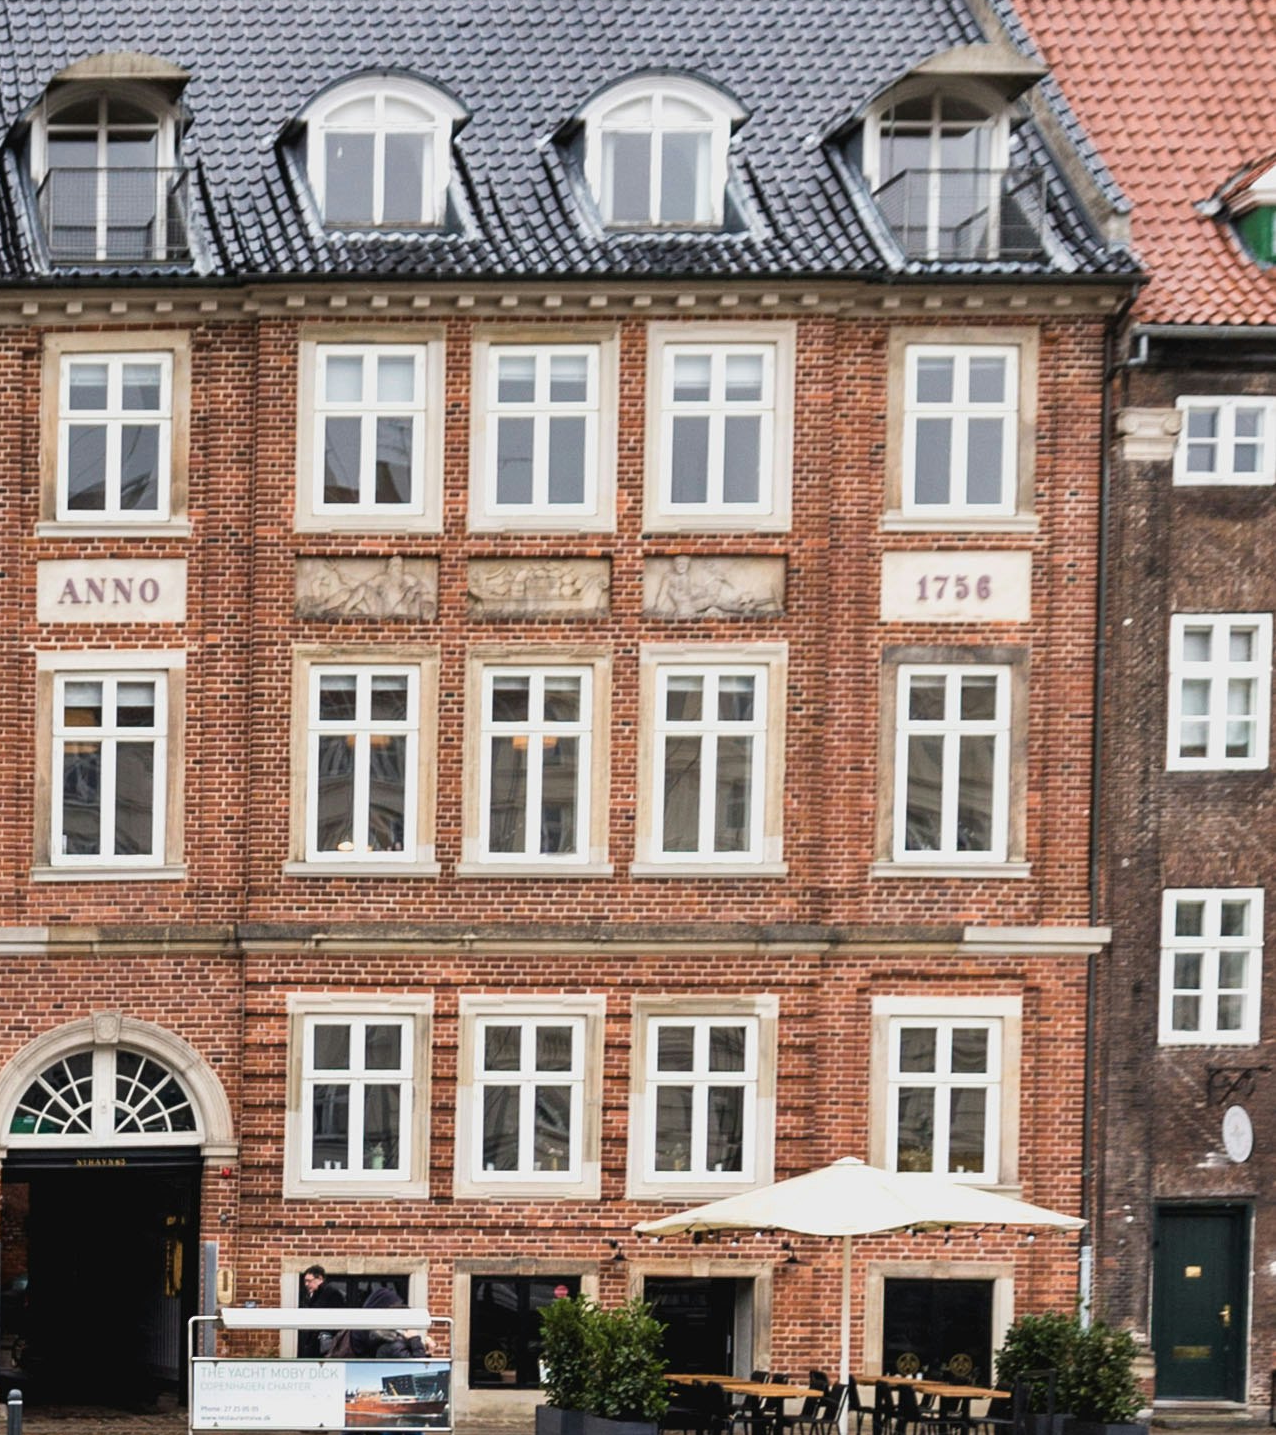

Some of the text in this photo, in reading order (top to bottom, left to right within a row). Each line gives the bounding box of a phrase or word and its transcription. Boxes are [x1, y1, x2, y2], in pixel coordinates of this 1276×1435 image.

[57, 577, 160, 604] ANNO
[916, 574, 992, 601] 1756
[200, 1367, 339, 1379] THE YACHT MOBY DICK
[200, 1381, 312, 1391] COPENHAGEN CHARTER
